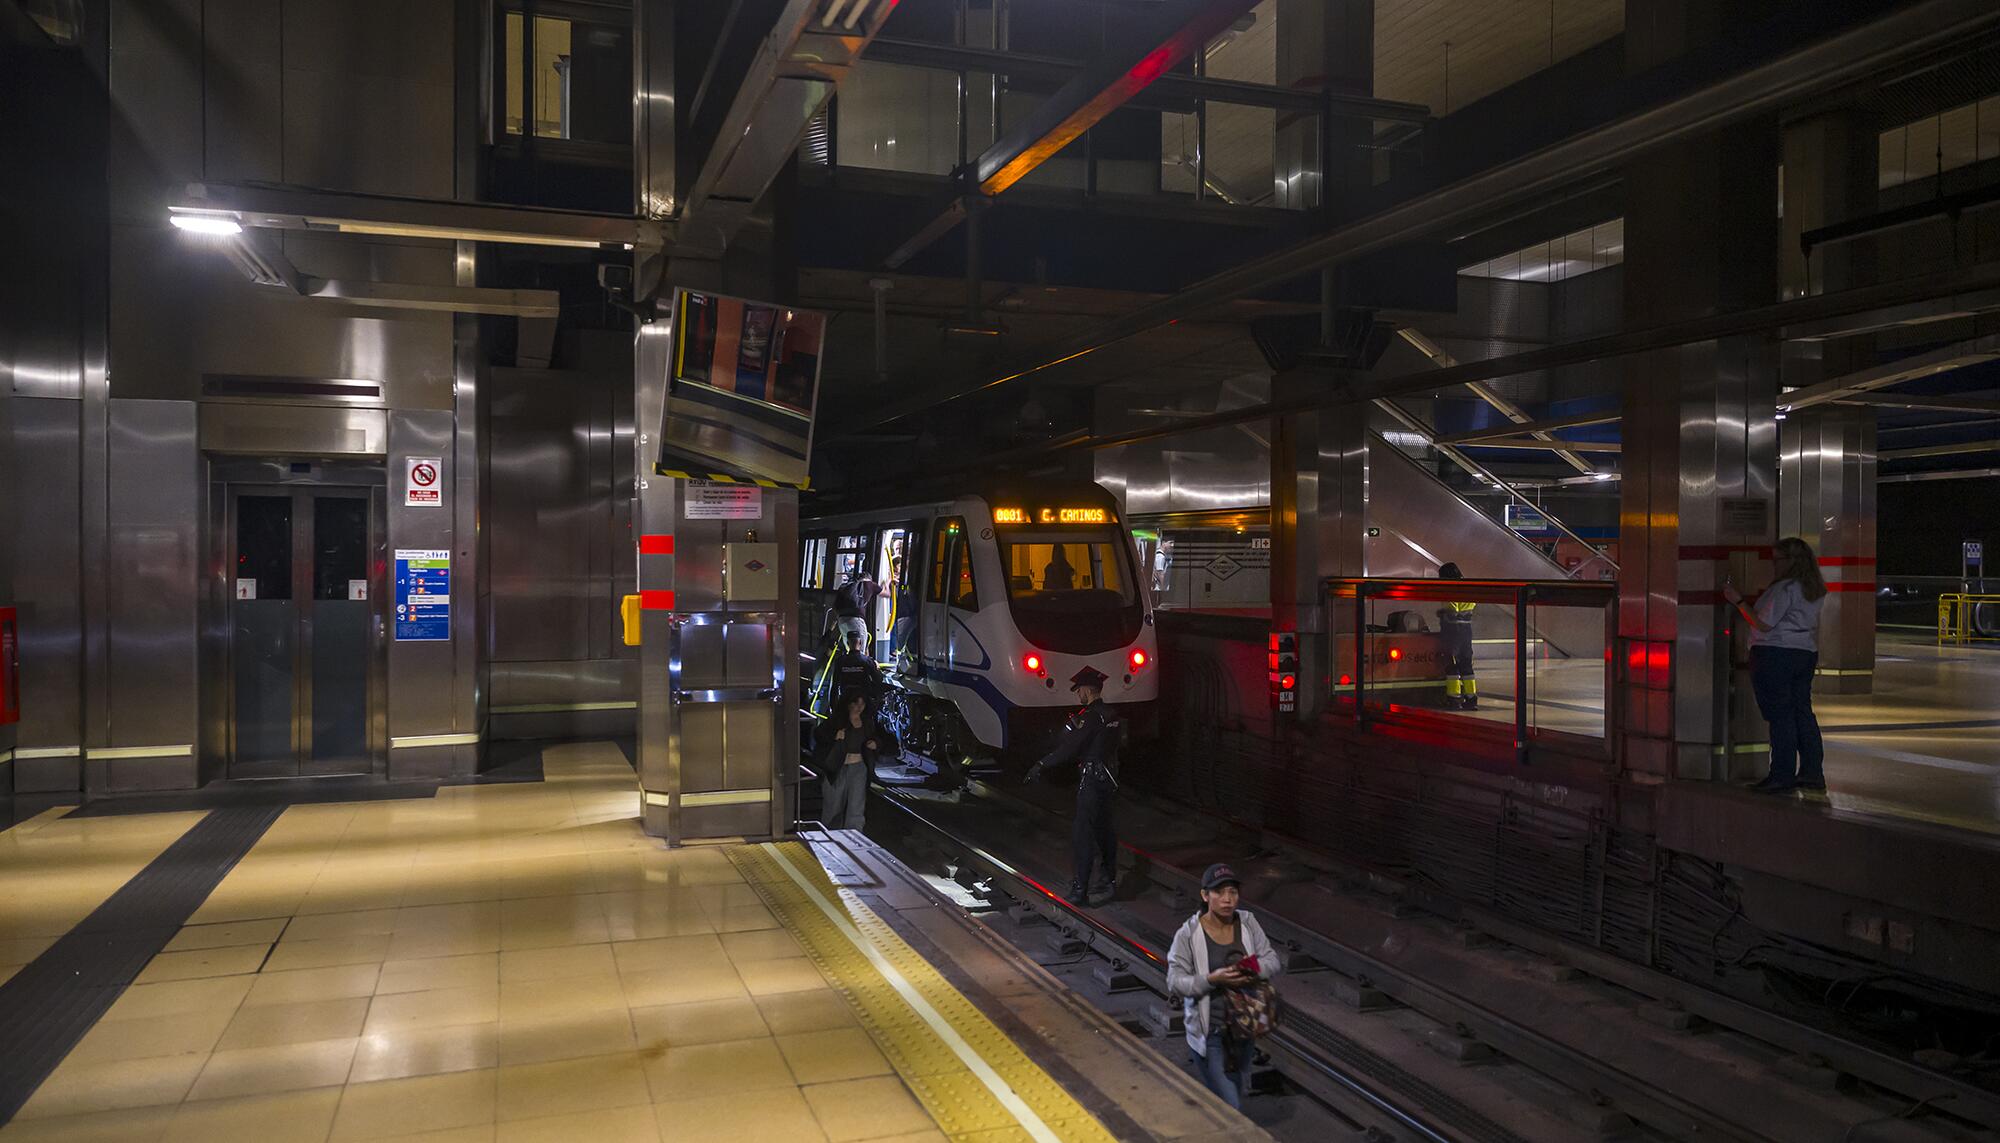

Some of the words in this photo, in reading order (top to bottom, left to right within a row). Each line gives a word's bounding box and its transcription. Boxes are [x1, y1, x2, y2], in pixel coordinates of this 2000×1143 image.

[996, 508, 1022, 521] 0001
[1042, 508, 1055, 521] C.
[1060, 508, 1103, 521] CAMINOS
